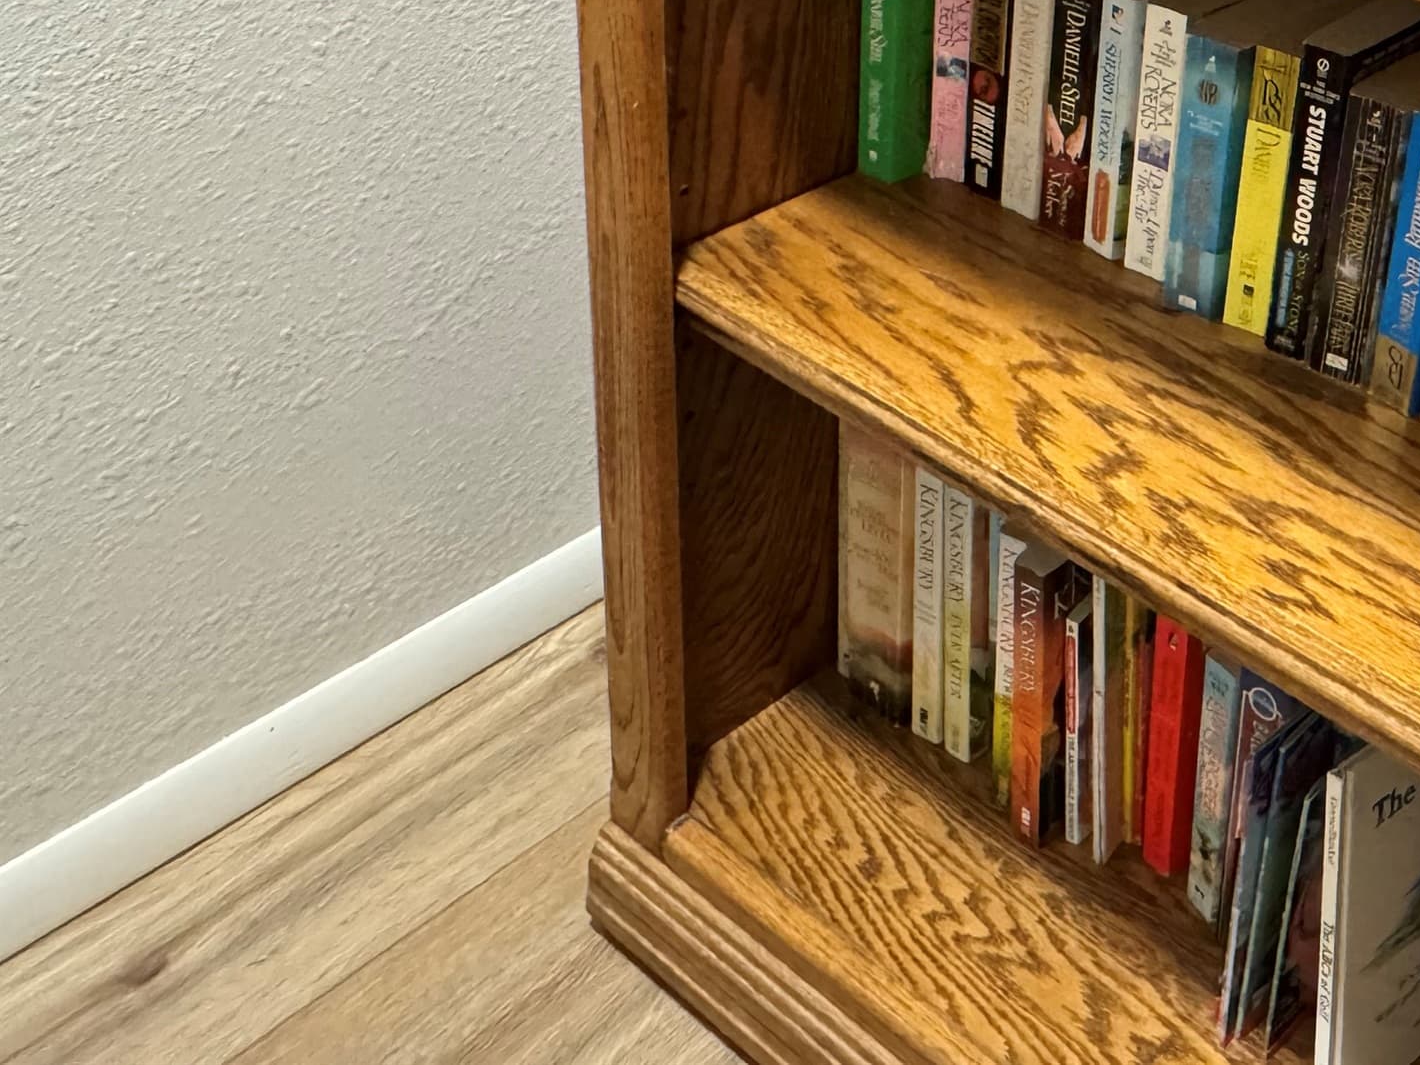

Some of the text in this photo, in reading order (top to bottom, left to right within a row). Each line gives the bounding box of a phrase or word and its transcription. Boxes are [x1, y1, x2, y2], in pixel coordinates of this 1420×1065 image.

[1058, 11, 1088, 128] DANIELLE STEEL
[1140, 64, 1162, 132] ROBERTS
[1158, 76, 1178, 127] NORA
[970, 98, 996, 168] TIMELINE
[1291, 104, 1327, 246] STUART WOODS
[917, 483, 939, 591] KINGSBURY
[946, 497, 968, 602] KINGSBURY
[1018, 581, 1040, 693] KINGSBURY
[1371, 783, 1417, 830] The
